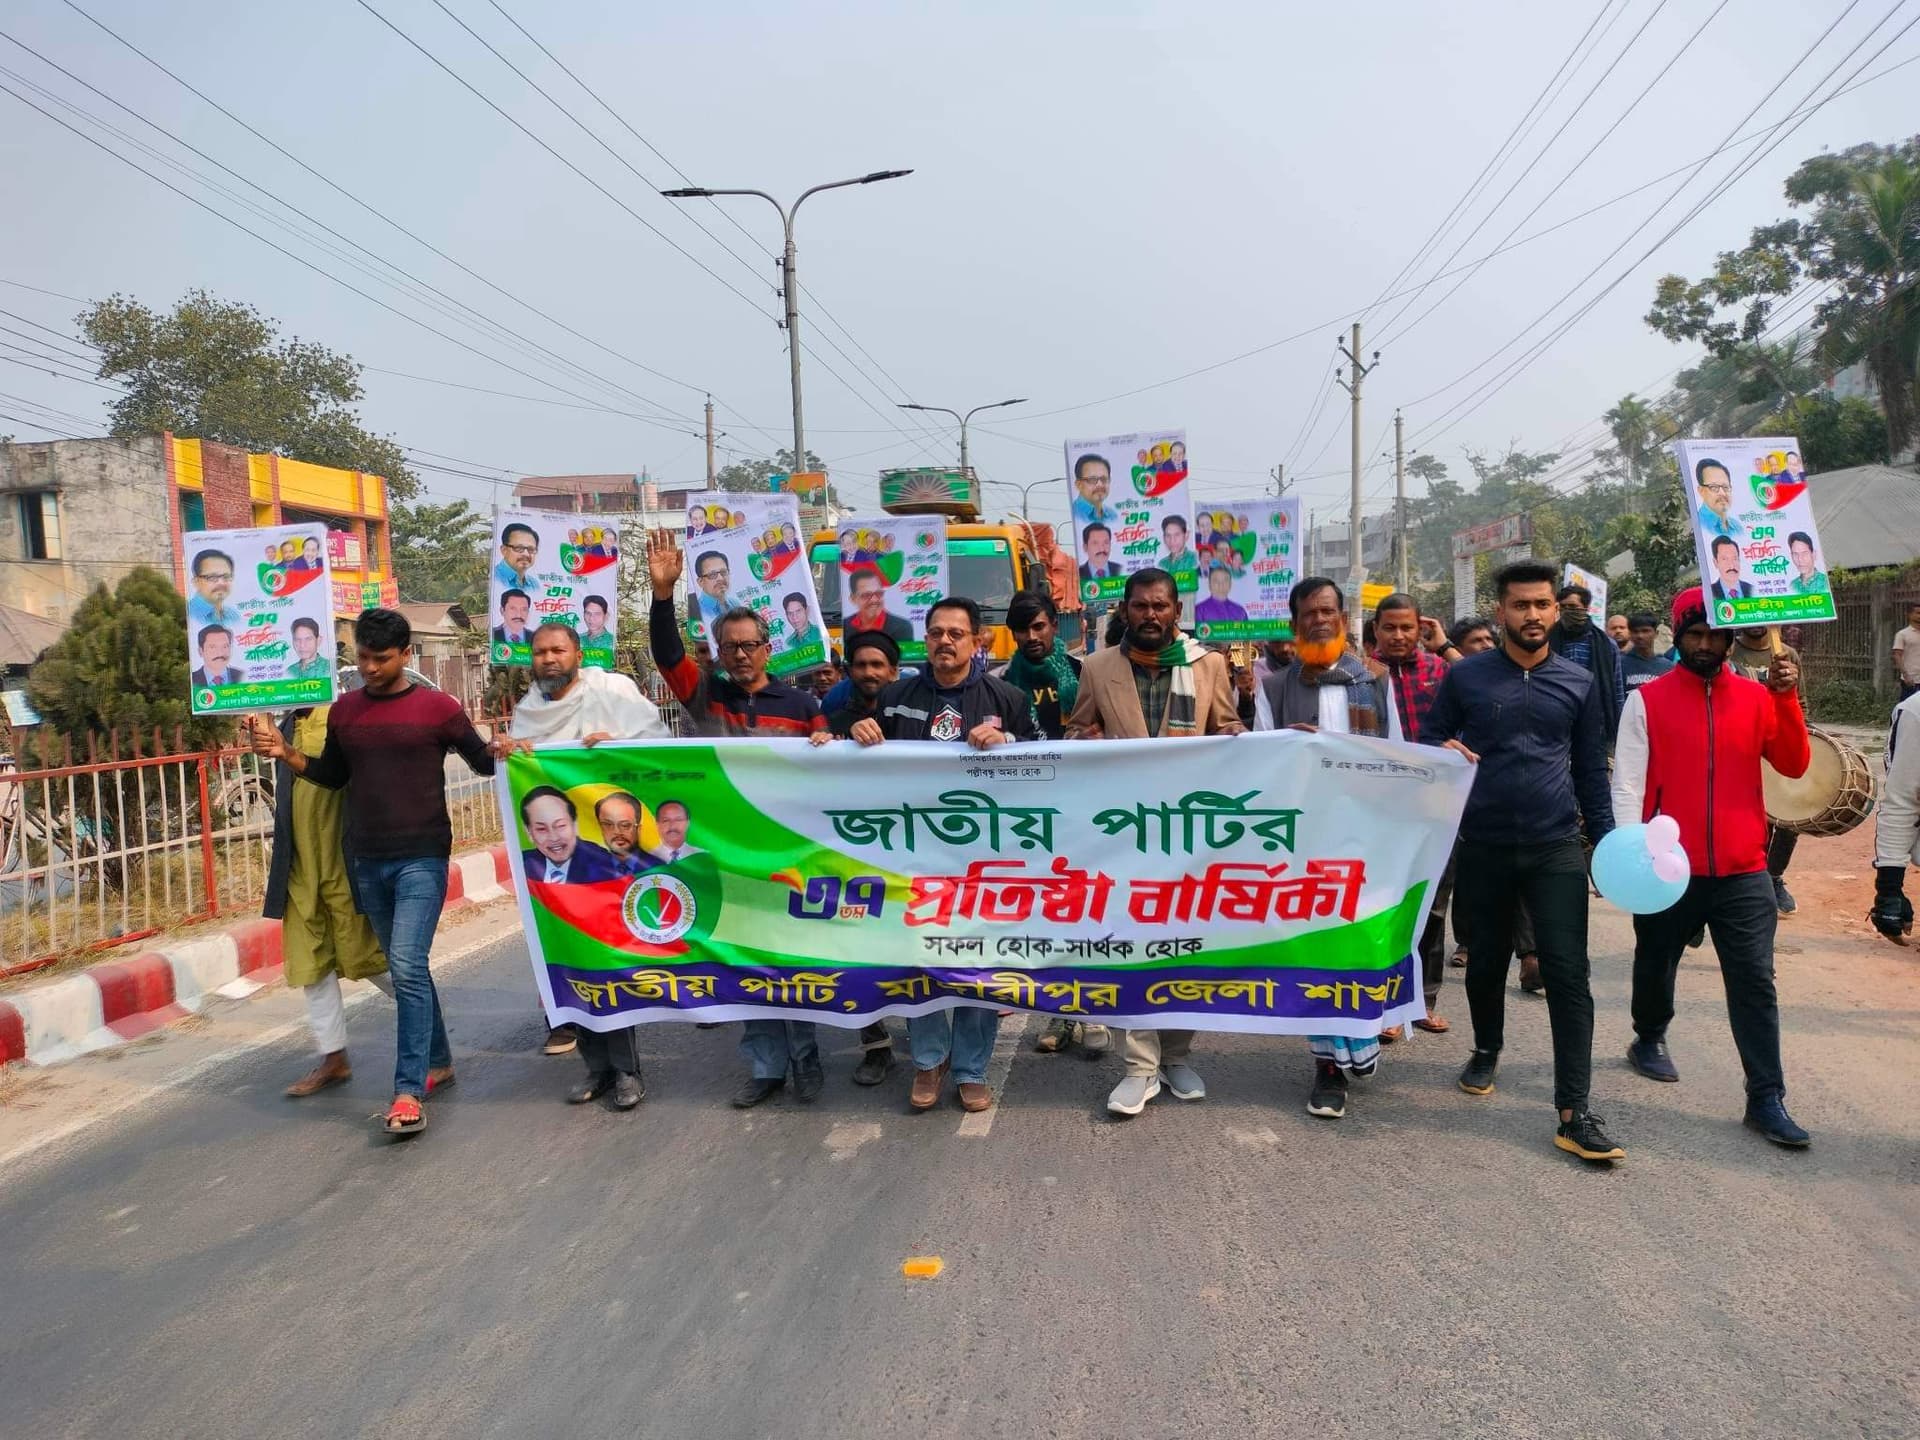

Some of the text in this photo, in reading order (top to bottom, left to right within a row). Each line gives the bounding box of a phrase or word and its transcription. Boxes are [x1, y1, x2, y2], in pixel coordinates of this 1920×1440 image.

[822, 789, 1304, 855] জাতীয় পার্টির
[903, 856, 1116, 927] প্রতিষ্ঠা
[1127, 858, 1367, 924] বার্ষিকী
[922, 935, 985, 957] সফল
[1145, 937, 1204, 960] হোক
[566, 968, 718, 1008] জাতীয়
[739, 971, 857, 1012] পার্টি,
[1145, 977, 1280, 1009] জেলা
[1296, 974, 1404, 1011] শাখা
